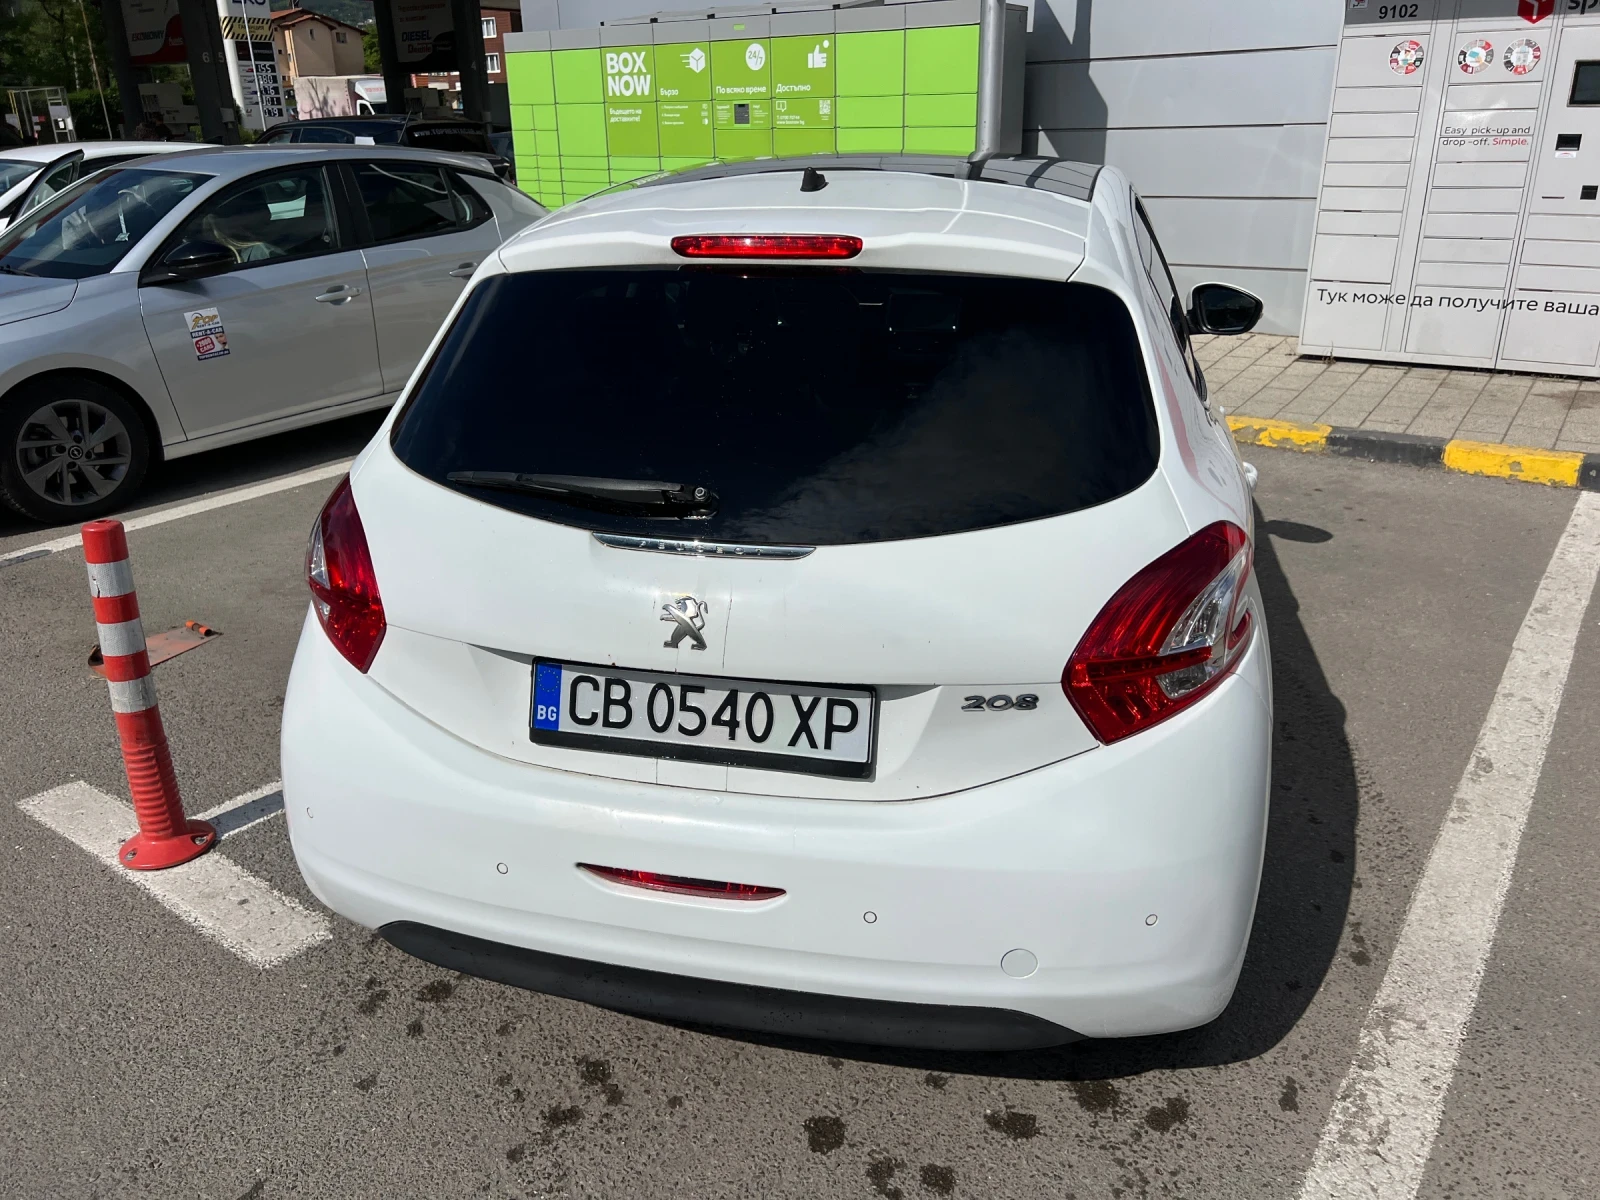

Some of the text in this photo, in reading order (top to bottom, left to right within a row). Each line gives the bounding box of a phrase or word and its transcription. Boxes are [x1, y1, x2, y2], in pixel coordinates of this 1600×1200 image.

[1378, 4, 1418, 19] 9102
[402, 30, 432, 42] DIESEL
[202, 52, 210, 63] 6
[218, 52, 224, 63] 5
[606, 51, 647, 74] BOX
[748, 50, 764, 65] 24/7
[607, 74, 651, 96] NOW
[716, 86, 725, 94] По
[745, 85, 767, 94] време
[776, 84, 811, 93] Достъпно
[660, 88, 679, 97] Бързо
[1444, 126, 1531, 136] Easy pick-up and
[1442, 138, 1466, 147] drop
[1492, 137, 1529, 147] Simple.
[1316, 288, 1600, 316] Тук може да получите ваша
[192, 327, 223, 338] RENT-A-CAR
[961, 694, 1039, 712] 208
[536, 705, 558, 721] BG
[569, 675, 859, 750] CB 0540 XP
